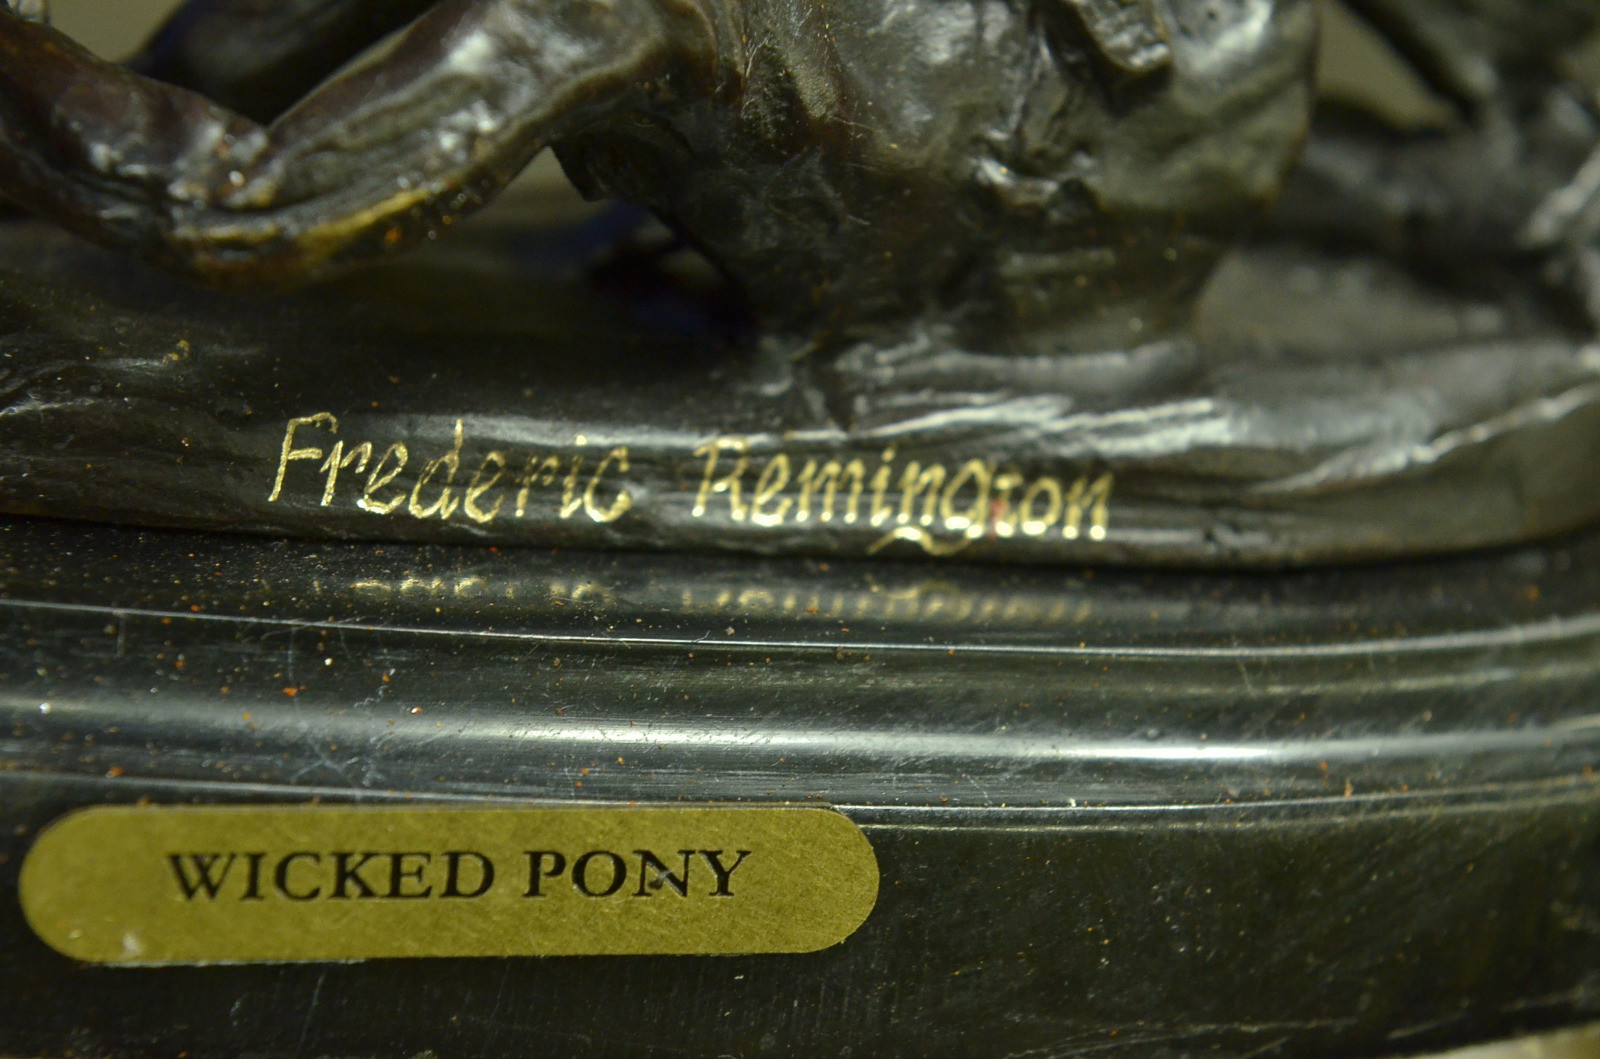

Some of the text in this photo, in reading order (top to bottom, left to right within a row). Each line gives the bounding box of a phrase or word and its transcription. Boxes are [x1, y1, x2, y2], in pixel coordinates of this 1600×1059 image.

[267, 411, 1114, 556] Frederic Remington
[168, 850, 753, 902] WICKED PONY
